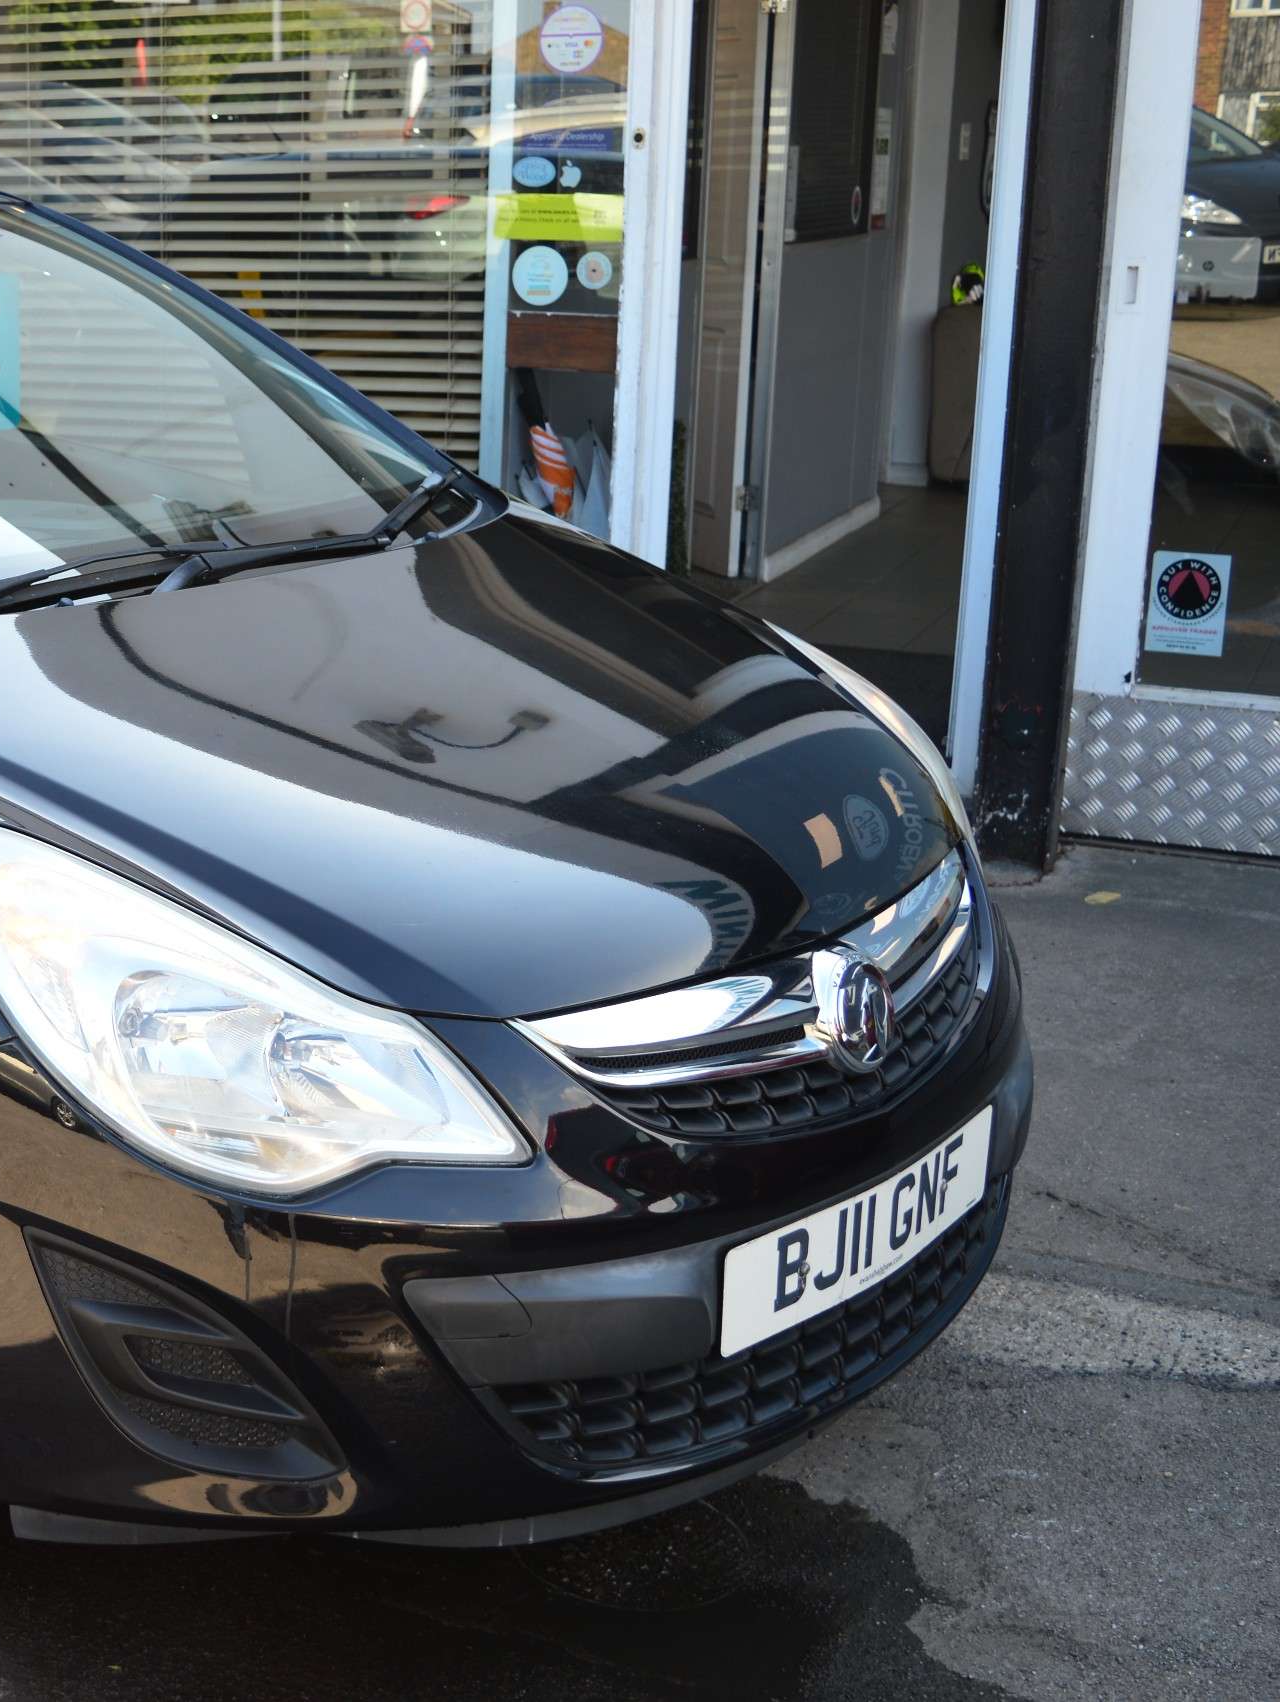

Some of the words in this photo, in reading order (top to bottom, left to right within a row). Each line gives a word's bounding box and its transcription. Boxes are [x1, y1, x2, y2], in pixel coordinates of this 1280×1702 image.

[1162, 562, 1183, 582] BUY
[1190, 561, 1219, 585] WITH
[1159, 586, 1219, 618] CONFIDENCE
[774, 1193, 877, 1313] BJ11
[890, 1133, 963, 1250] GNF
